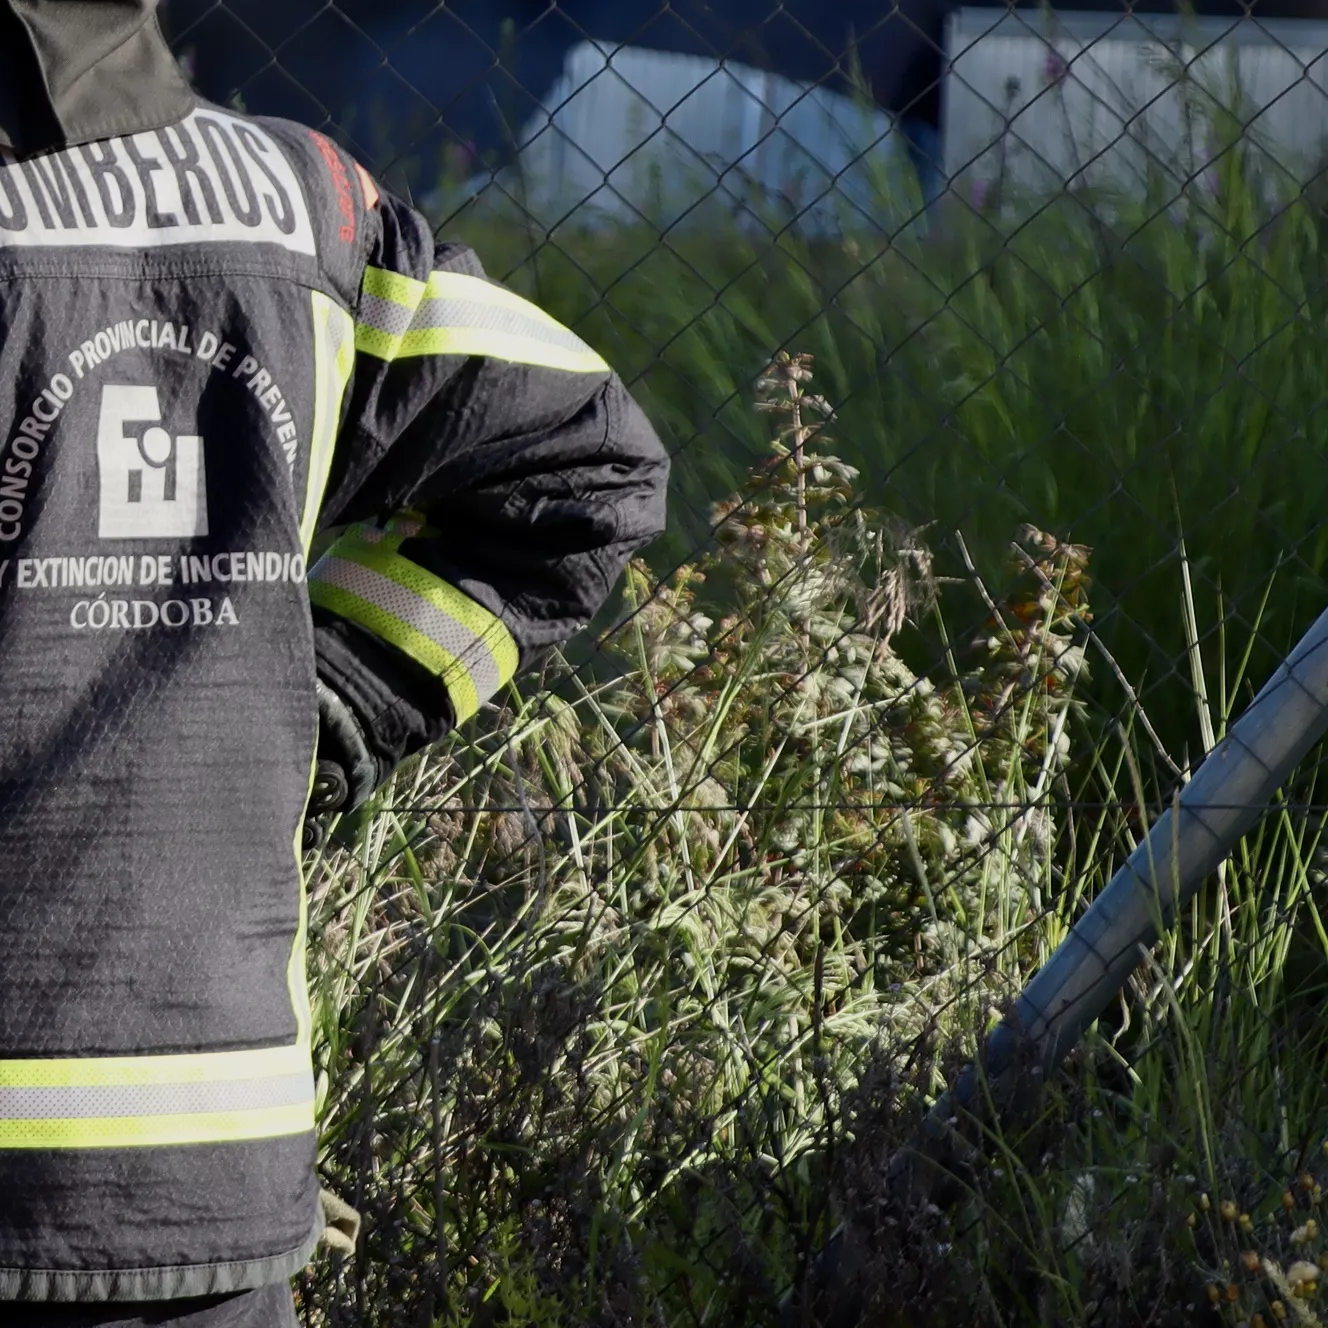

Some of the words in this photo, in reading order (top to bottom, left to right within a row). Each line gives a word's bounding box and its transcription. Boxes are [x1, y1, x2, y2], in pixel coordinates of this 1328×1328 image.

[69, 319, 192, 379] PROVINCIAL
[196, 331, 237, 370] DE
[232, 355, 297, 467] PREVEN
[17, 555, 135, 588] EXTINCION
[140, 555, 174, 585] DE
[181, 551, 307, 585] INCENDIO
[69, 592, 240, 629] CÓRDOBA
